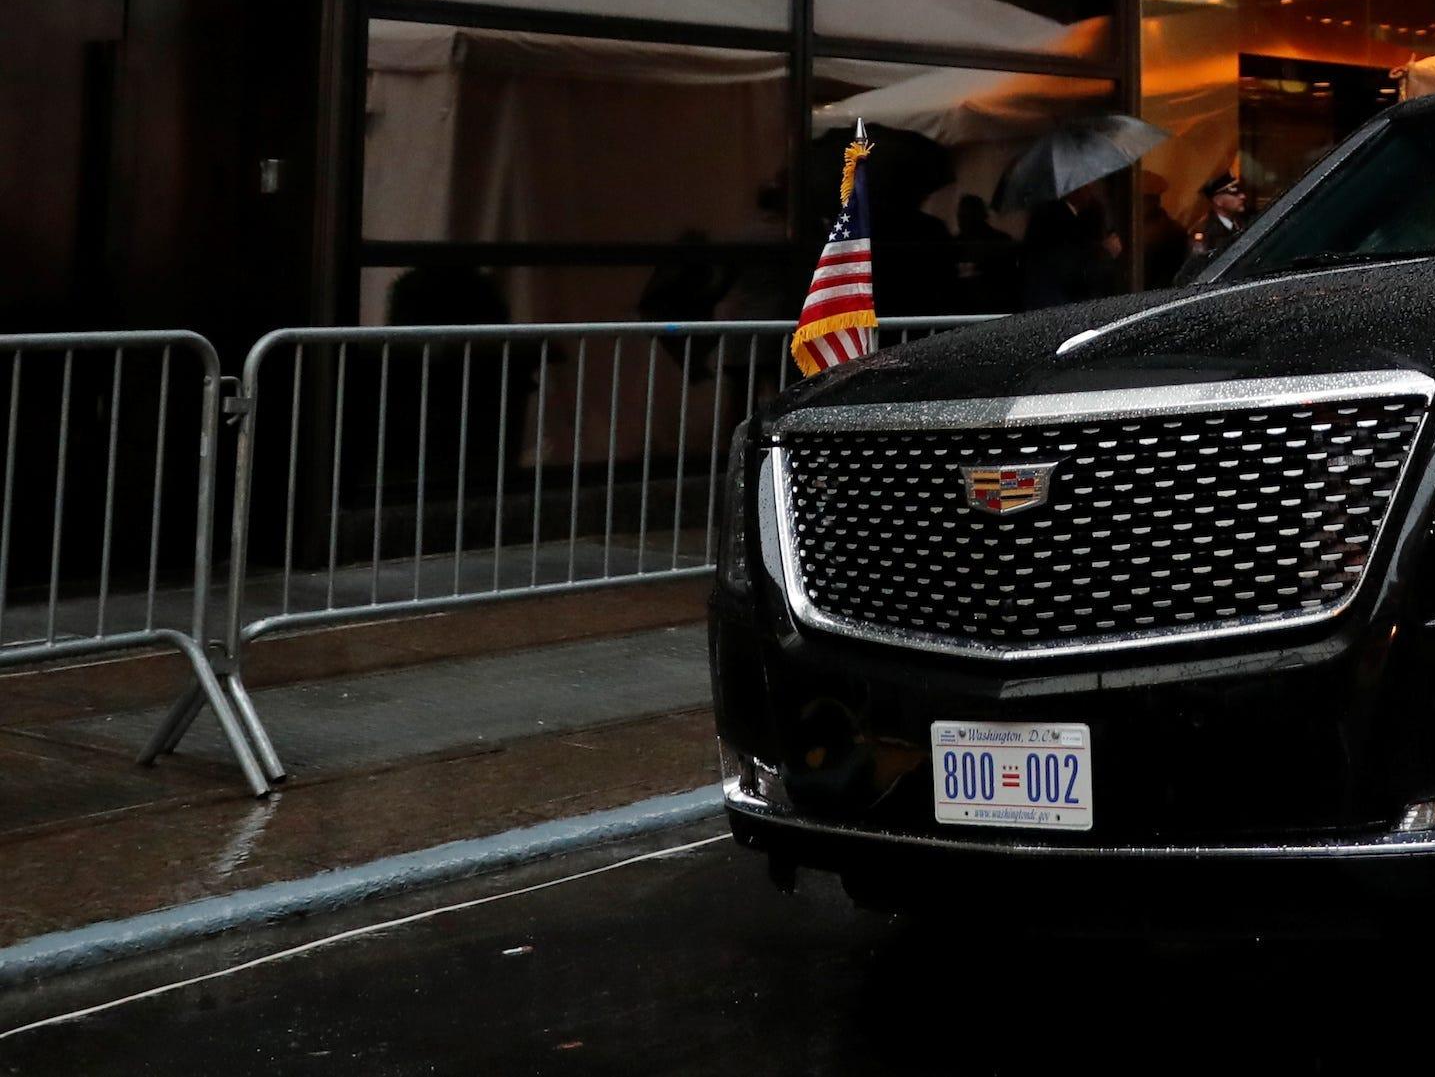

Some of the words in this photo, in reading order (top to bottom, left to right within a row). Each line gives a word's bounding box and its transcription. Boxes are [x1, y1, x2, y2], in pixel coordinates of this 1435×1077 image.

[969, 728, 1024, 744] Washington,
[944, 751, 994, 800] 800
[1026, 753, 1079, 804] 002
